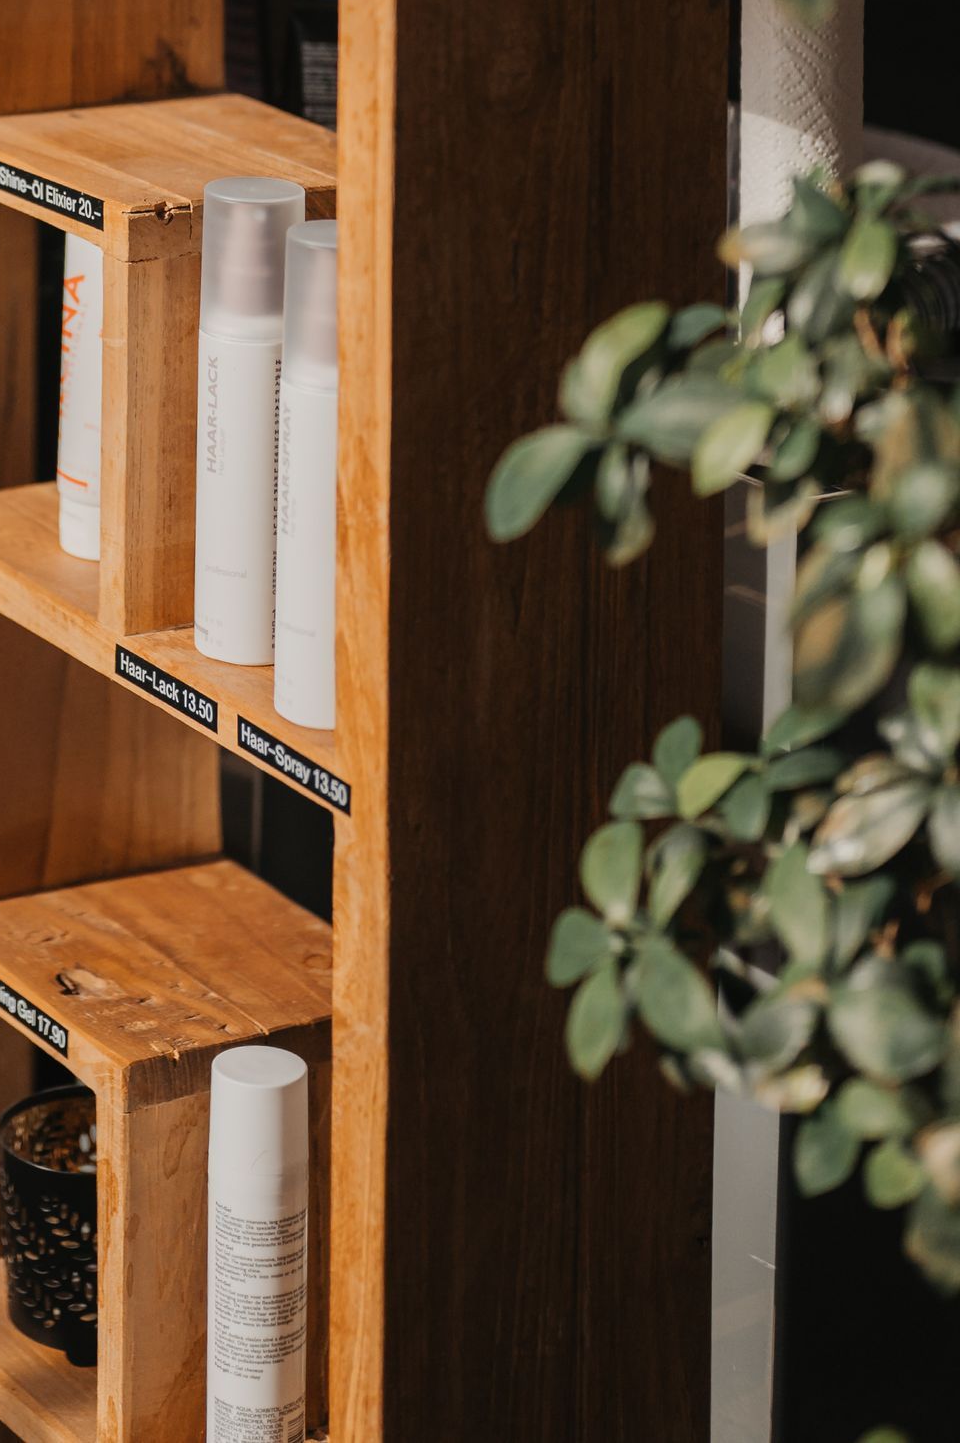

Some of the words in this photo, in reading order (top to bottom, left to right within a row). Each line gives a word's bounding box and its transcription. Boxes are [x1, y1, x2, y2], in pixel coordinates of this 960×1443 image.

[45, 184, 77, 213] Elixier
[206, 355, 219, 474] HAAR-LACK
[120, 652, 180, 704] Haar-Lack
[182, 690, 214, 723] 13.50
[240, 723, 310, 784] Haar-Spray
[312, 768, 348, 807] 13.50
[17, 999, 36, 1027] Gel
[38, 1014, 66, 1048] 17.90
